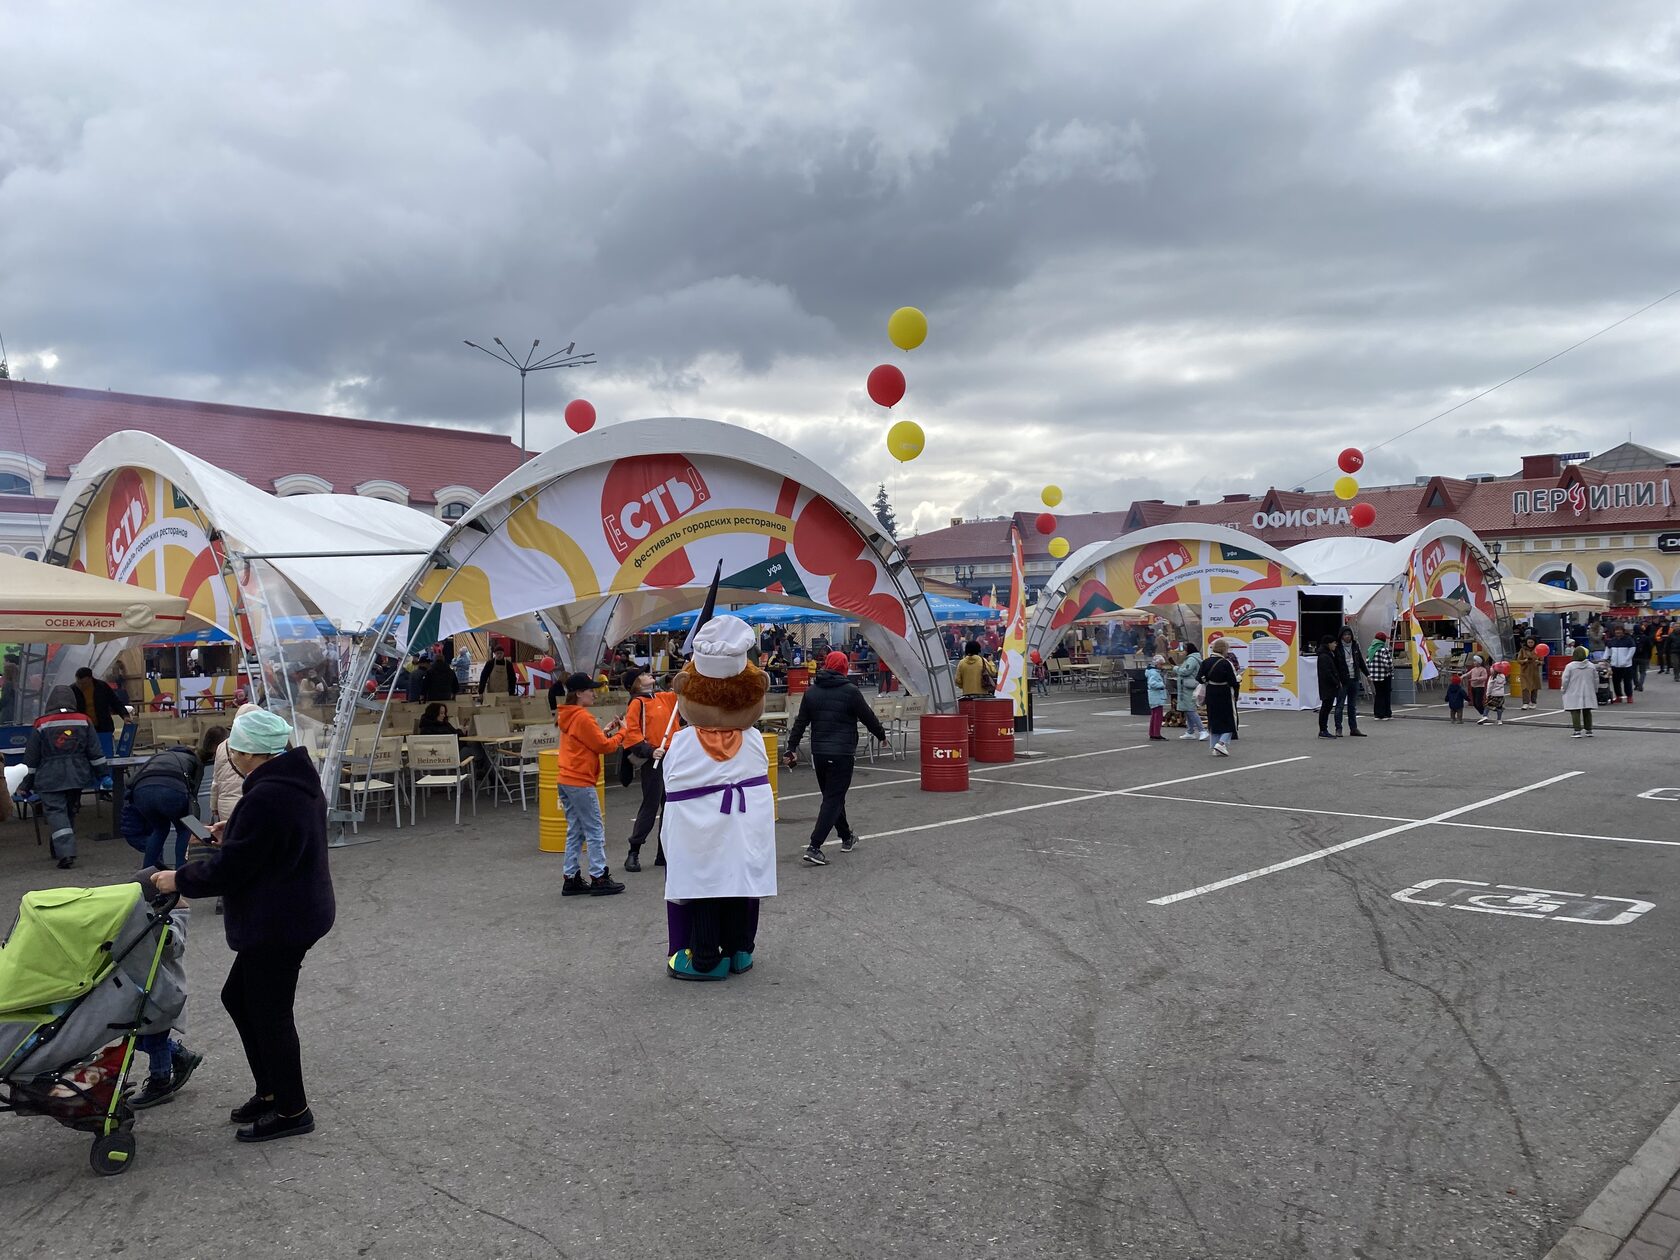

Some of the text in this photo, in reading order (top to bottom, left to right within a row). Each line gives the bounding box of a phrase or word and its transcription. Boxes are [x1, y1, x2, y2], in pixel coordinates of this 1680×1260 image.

[1252, 506, 1354, 529] ОФИСМА
[634, 516, 787, 569] фестиваль городских ресторанов
[767, 563, 783, 577] уфа
[1638, 580, 1648, 592] P
[45, 617, 116, 629] ОСВЕЖАЙСЯ
[532, 737, 556, 746] AMSTEL
